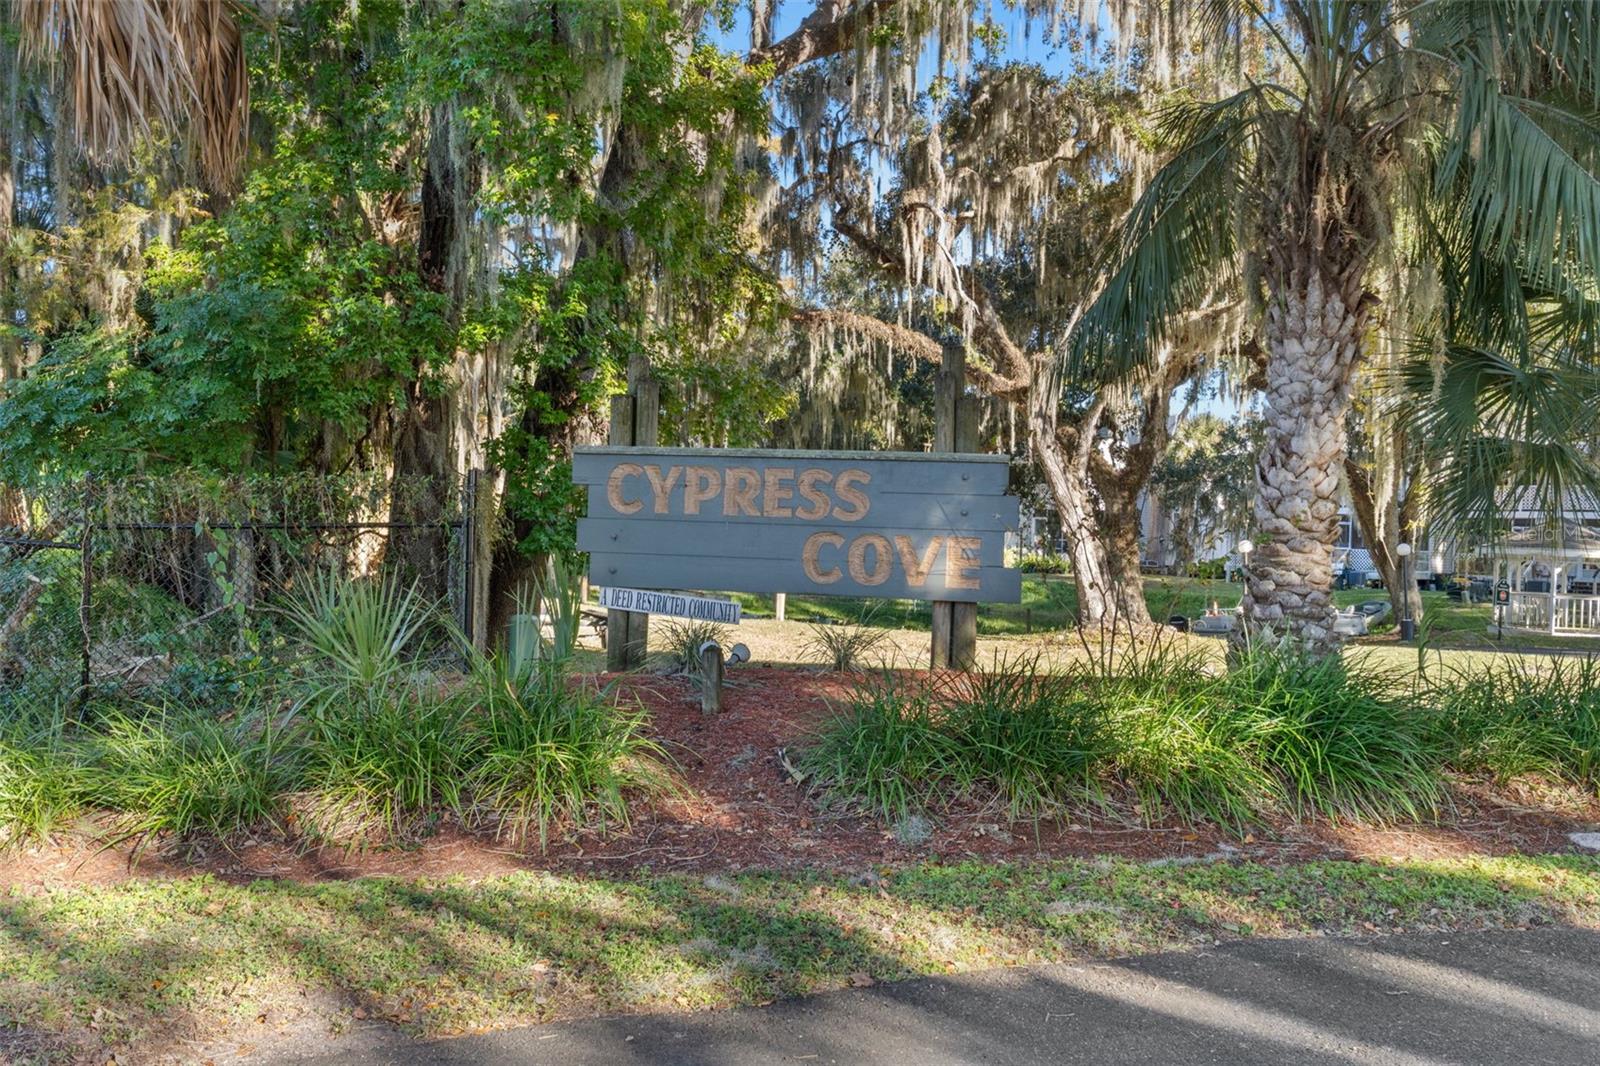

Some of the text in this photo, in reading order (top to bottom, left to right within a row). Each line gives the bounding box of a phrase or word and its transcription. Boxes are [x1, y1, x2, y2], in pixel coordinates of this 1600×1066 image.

[606, 463, 872, 522] CYPRESS
[802, 531, 983, 590] COVE
[600, 587, 739, 623] A DEED RESTRICTED COMMUNITY
